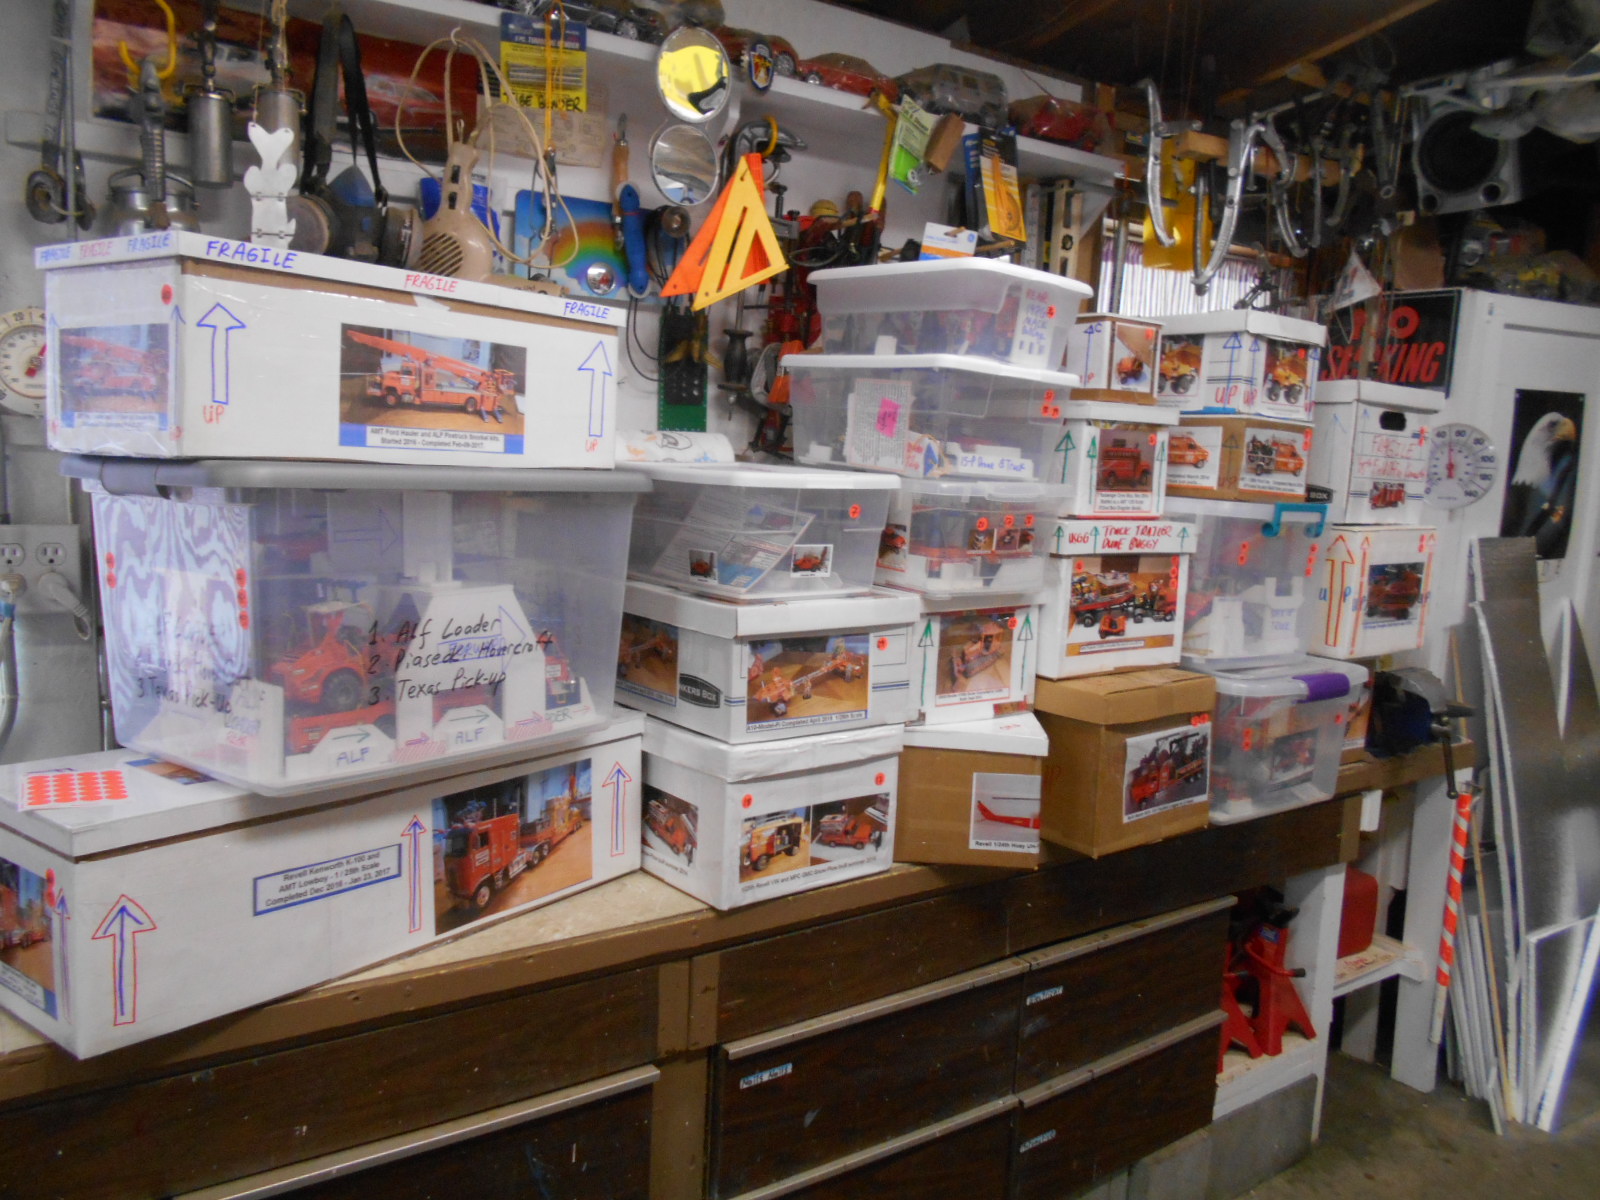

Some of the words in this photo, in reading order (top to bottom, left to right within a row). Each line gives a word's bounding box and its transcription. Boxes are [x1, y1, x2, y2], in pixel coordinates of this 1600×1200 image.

[503, 92, 532, 106] TBE
[126, 233, 171, 253] FRAGILE
[205, 239, 298, 270] FRAGILE
[404, 273, 459, 294] FRAGILE
[563, 301, 611, 320] FRAGILE
[1321, 341, 1447, 383] SMKING
[1214, 384, 1239, 405] UP
[203, 405, 225, 425] UP
[421, 440, 451, 448] Completed
[585, 440, 599, 454] UP
[1128, 537, 1159, 550] BUGGY
[441, 613, 501, 640] Loader
[397, 678, 442, 702] Texas
[451, 666, 507, 698] Pick-up
[702, 689, 717, 701] BOX
[455, 727, 485, 745] ALF
[336, 747, 370, 767] ALF
[282, 870, 307, 881] Revell
[309, 862, 345, 874] Kenworth
[366, 852, 381, 860] and
[278, 883, 297, 893] AMT
[297, 875, 329, 888] Lowboy
[361, 862, 381, 871] Scale
[264, 890, 308, 906] Completed
[309, 885, 325, 895] Dec
[348, 876, 362, 884] Jan
